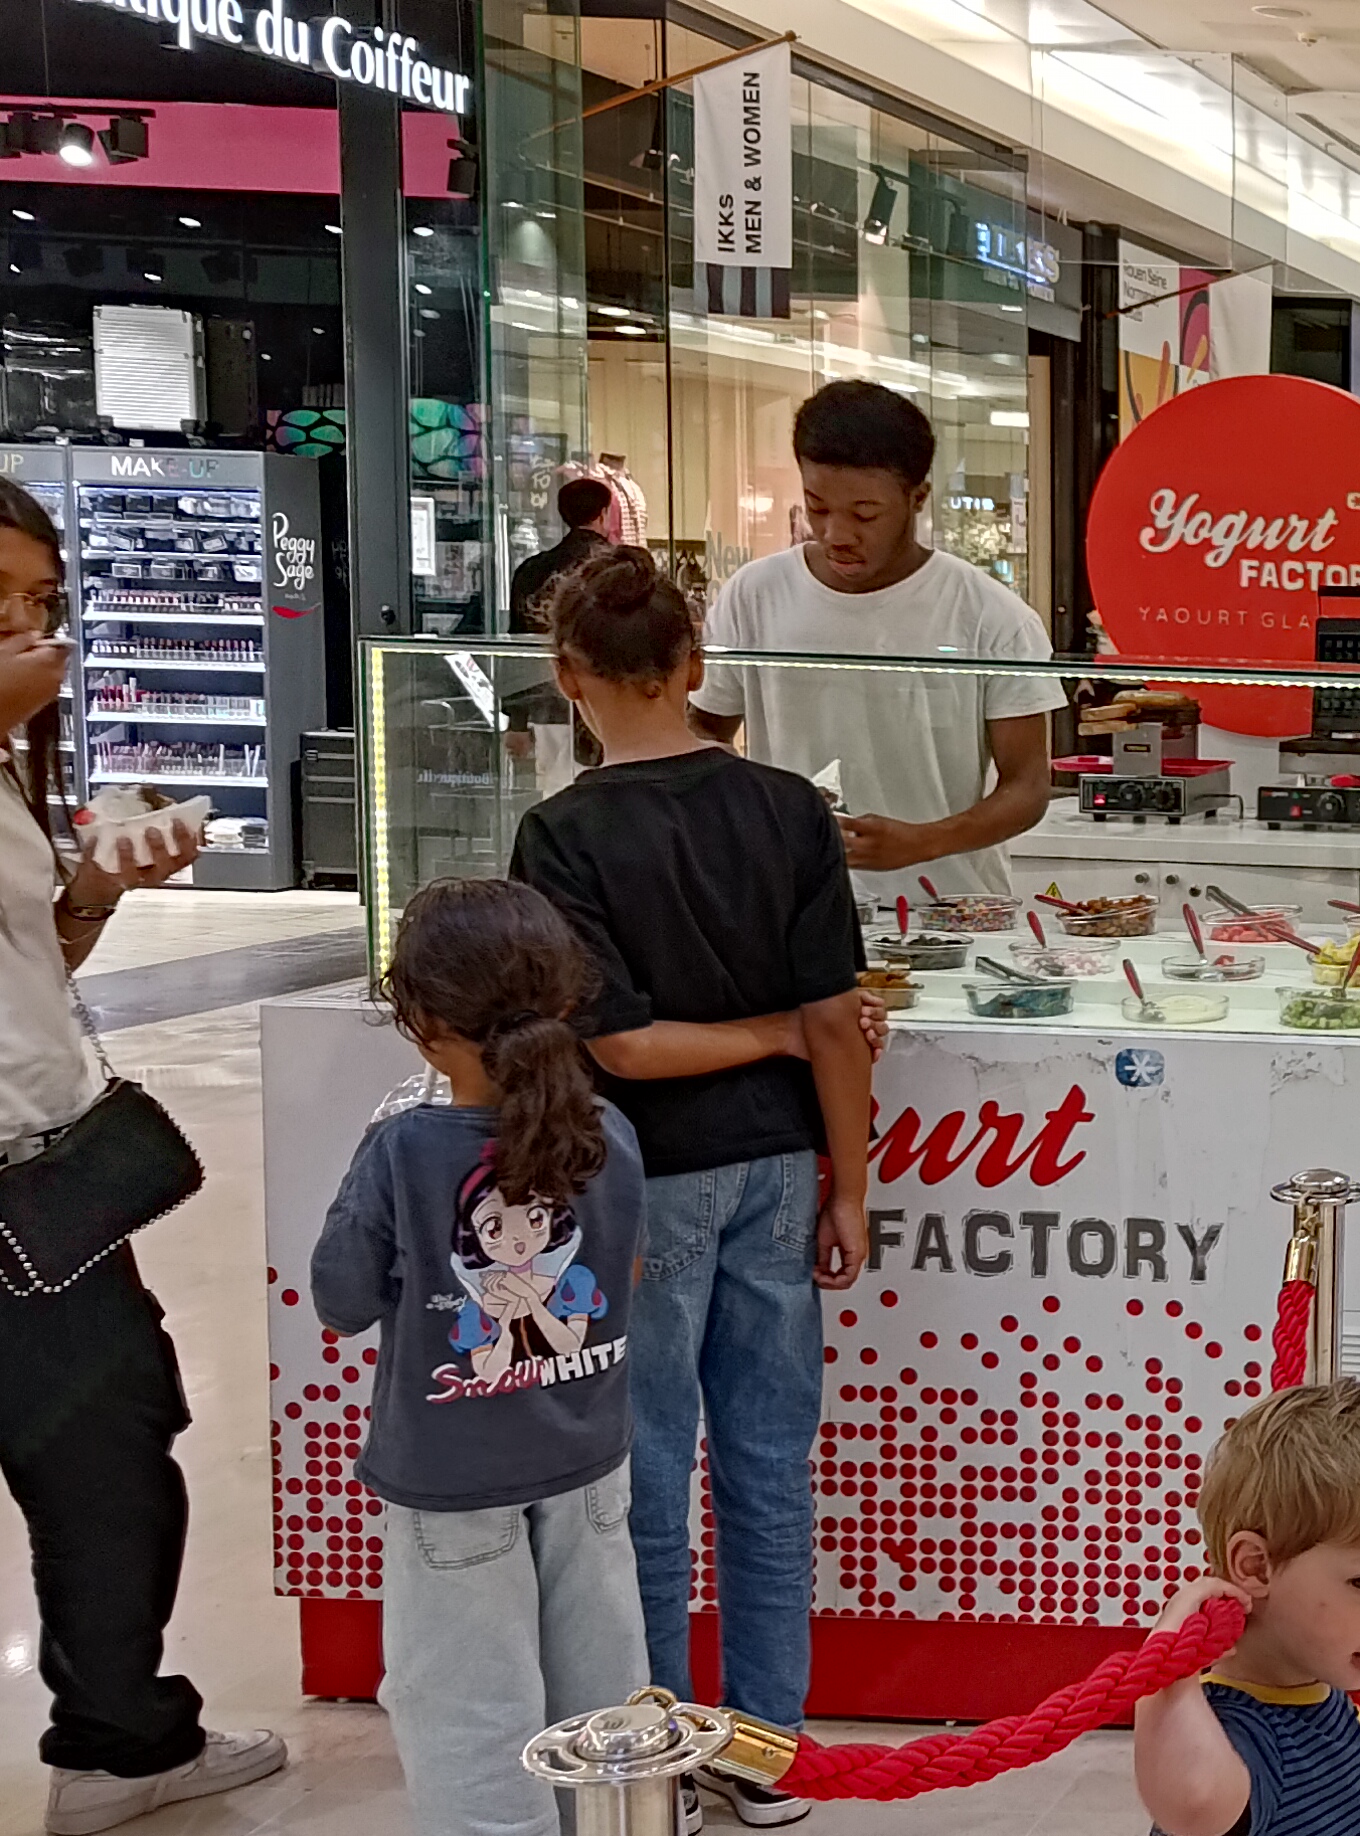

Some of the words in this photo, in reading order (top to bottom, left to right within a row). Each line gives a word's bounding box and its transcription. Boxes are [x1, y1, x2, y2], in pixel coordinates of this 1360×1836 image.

[255, 8, 309, 64] du
[322, 16, 470, 114] Coiffeur
[743, 72, 762, 167] WOMEN
[744, 176, 762, 191] &
[718, 193, 735, 252] IKKS
[744, 200, 762, 254] MEN
[111, 455, 219, 477] MAKE-UP
[273, 512, 315, 565] Peggy
[1139, 488, 1338, 568] Yogurt
[273, 551, 315, 590] Sage
[1139, 606, 1248, 626] YAOURT
[1261, 611, 1311, 630] GLA
[869, 1084, 1095, 1187] urt
[866, 1207, 1224, 1285] FACTORY
[540, 1335, 628, 1388] WHITE
